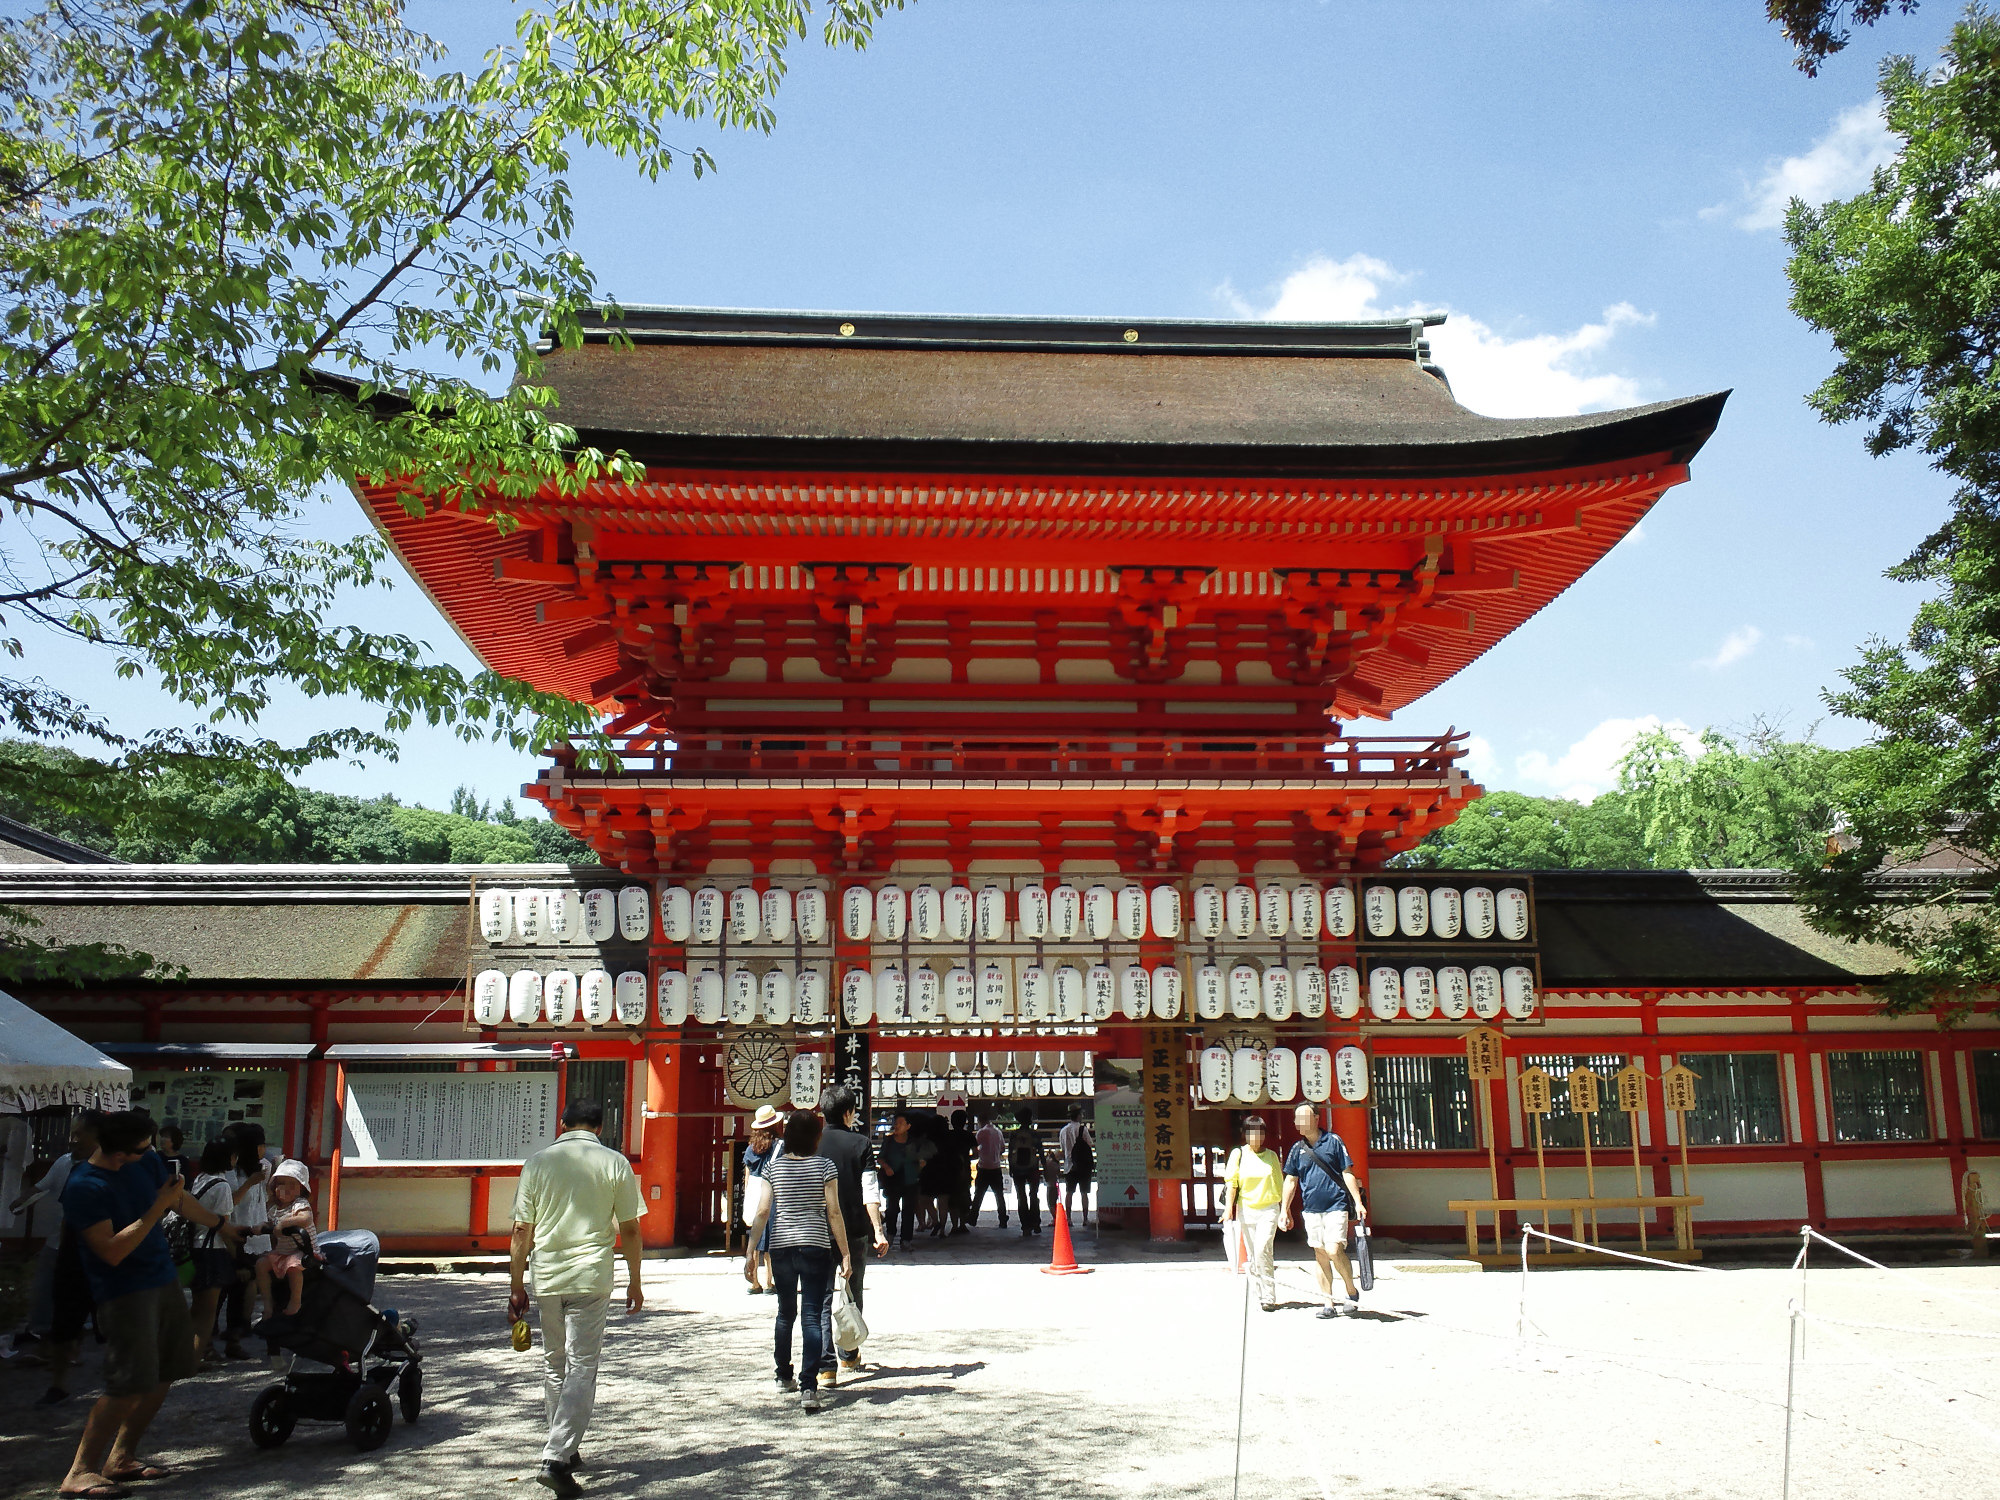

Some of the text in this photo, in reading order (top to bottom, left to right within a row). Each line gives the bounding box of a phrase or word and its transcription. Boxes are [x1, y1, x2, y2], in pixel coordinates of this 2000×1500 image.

[588, 901, 598, 917] 藤田
[662, 902, 671, 917] 中村
[1340, 971, 1350, 992] 株式会社
[1384, 976, 1396, 991] 小林
[693, 984, 701, 1000] 井上
[985, 983, 994, 1006] 吉田
[1307, 971, 1321, 1014] 吉川測器
[1330, 973, 1344, 1014] 吉川測器
[1479, 1032, 1492, 1075] 天皇陛下
[1627, 1073, 1638, 1108] 三笠宮家
[1675, 1073, 1687, 1108] 高円宮家
[1115, 1119, 1145, 1127] 下鴨神
[1099, 1131, 1145, 1141] 本殿・大炊殿・
[1111, 1143, 1145, 1151] 特別公
